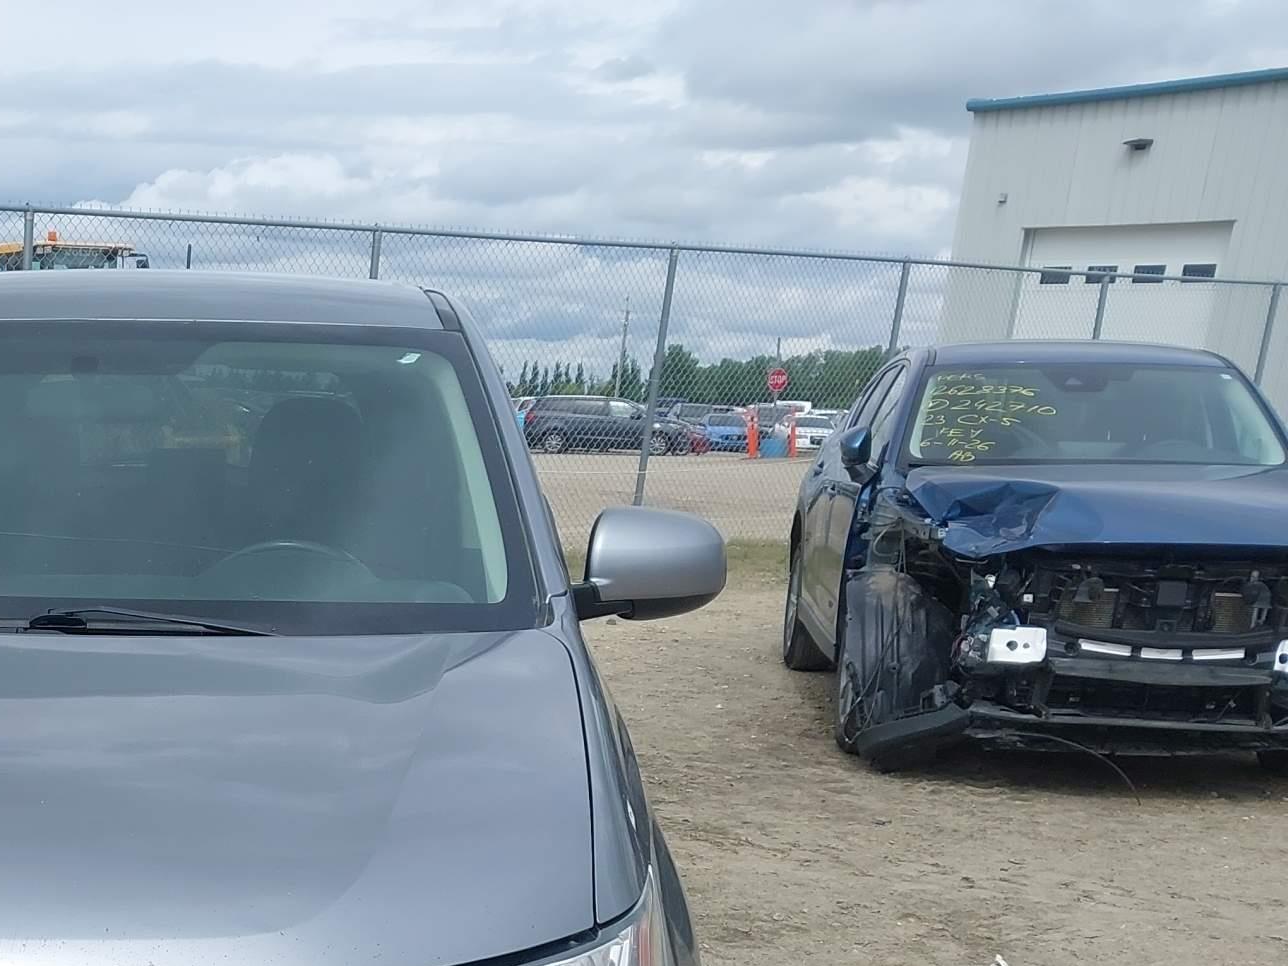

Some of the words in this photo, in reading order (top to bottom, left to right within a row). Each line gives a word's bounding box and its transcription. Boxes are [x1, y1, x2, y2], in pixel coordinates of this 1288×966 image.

[769, 375, 787, 384] STOP
[921, 414, 946, 426] 23
[958, 414, 1022, 426] CX-5
[920, 437, 996, 451] 6-11-26
